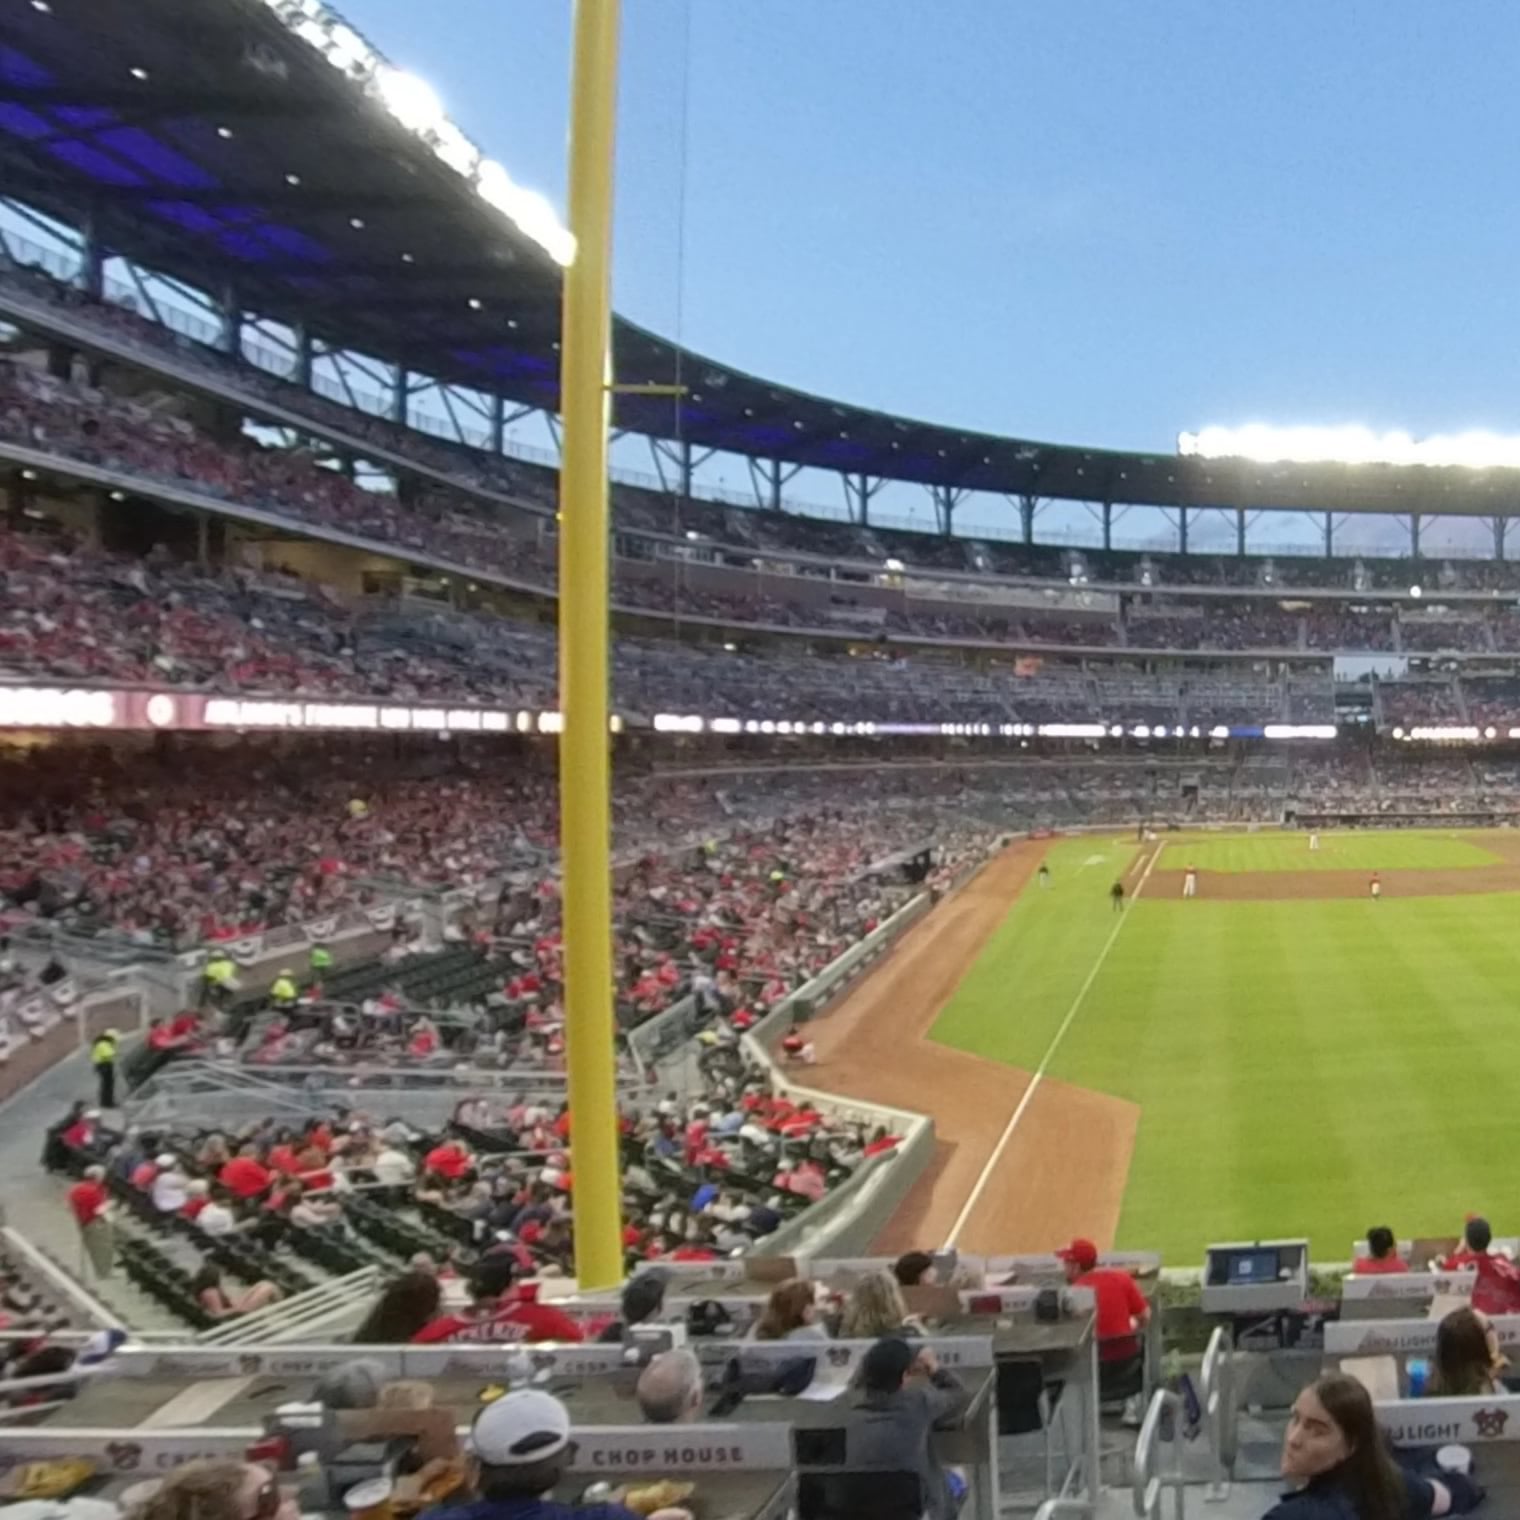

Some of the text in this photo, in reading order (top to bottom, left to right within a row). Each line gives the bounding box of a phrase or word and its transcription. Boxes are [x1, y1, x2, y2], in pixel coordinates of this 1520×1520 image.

[1406, 1423, 1462, 1441] LIGHT
[591, 1446, 744, 1467] CHOP HOUSE
